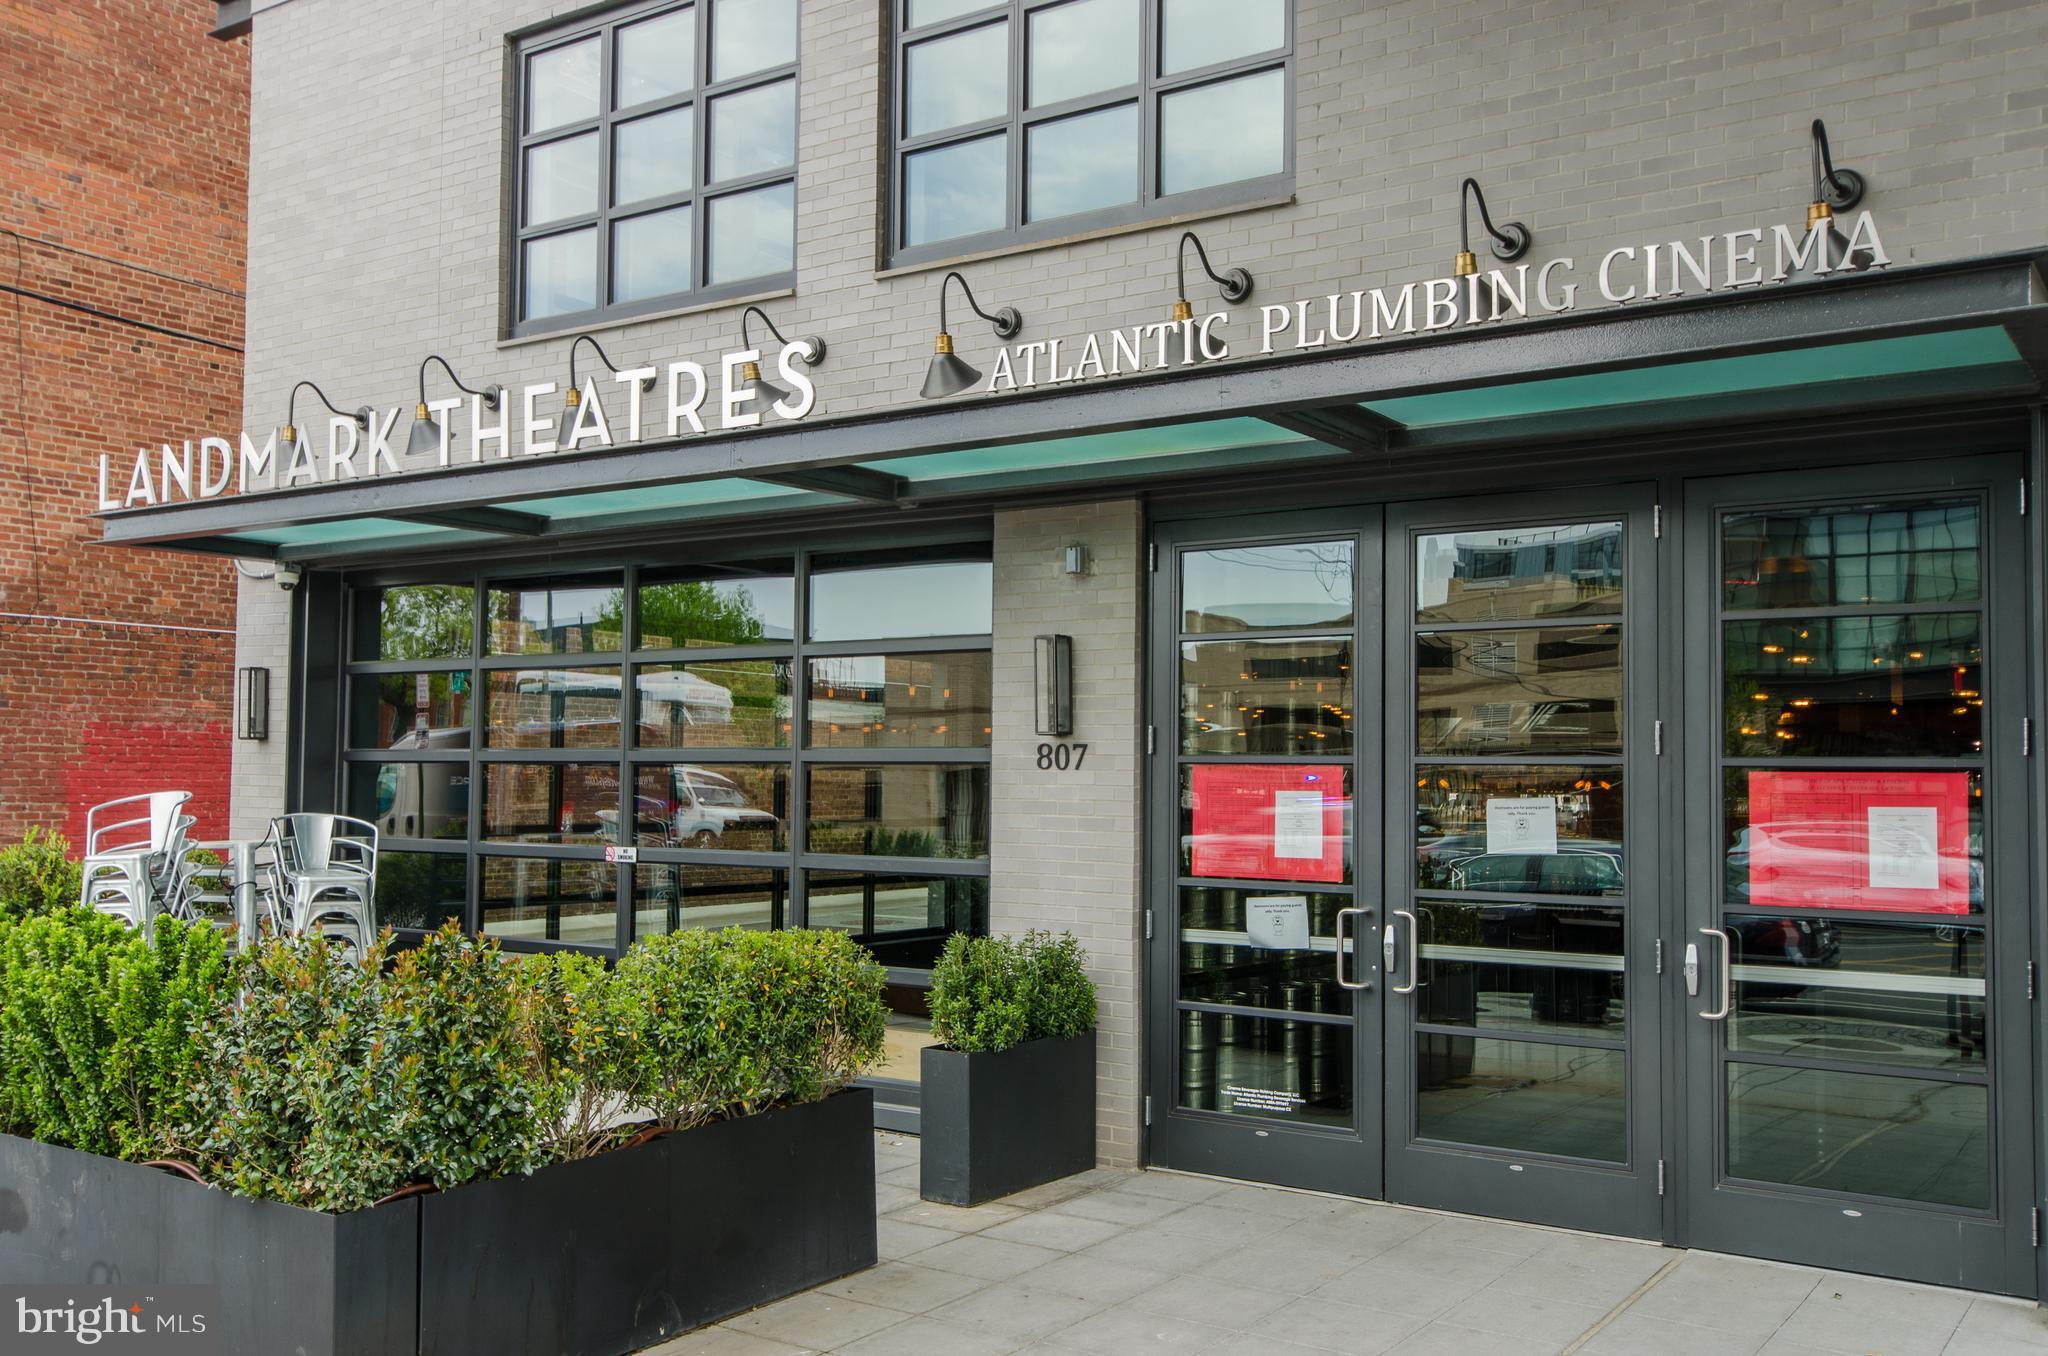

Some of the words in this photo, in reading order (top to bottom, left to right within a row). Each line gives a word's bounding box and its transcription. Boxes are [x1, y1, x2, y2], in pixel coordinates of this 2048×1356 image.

[986, 312, 1230, 393] ATLANTIC
[1259, 257, 1579, 355] PLUMBING
[1598, 210, 1892, 304] CINEMA
[99, 407, 402, 510] LANDMARK
[428, 340, 817, 467] THEATRES
[1037, 743, 1088, 770] 807
